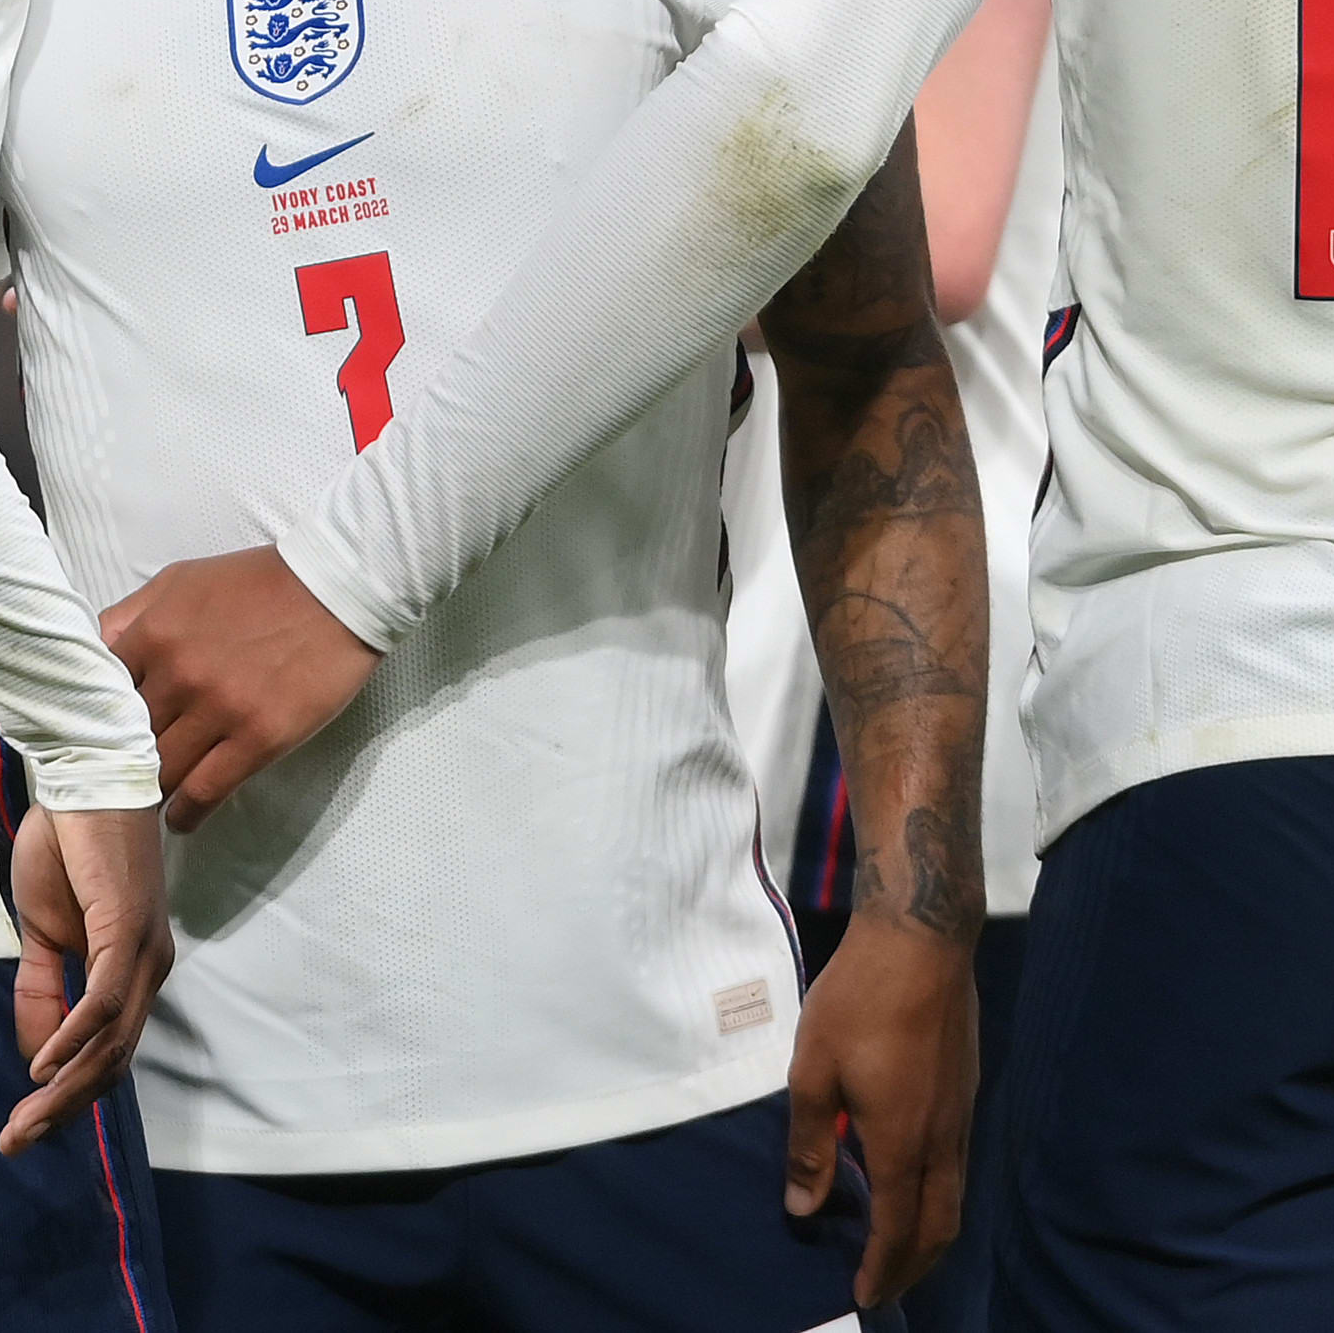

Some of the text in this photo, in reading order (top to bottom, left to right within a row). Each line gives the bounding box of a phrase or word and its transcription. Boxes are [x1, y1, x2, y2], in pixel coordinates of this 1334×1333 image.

[271, 177, 377, 212] IVORY COAST
[271, 198, 390, 235] 29 MARCH 2022
[294, 249, 406, 456] 7
